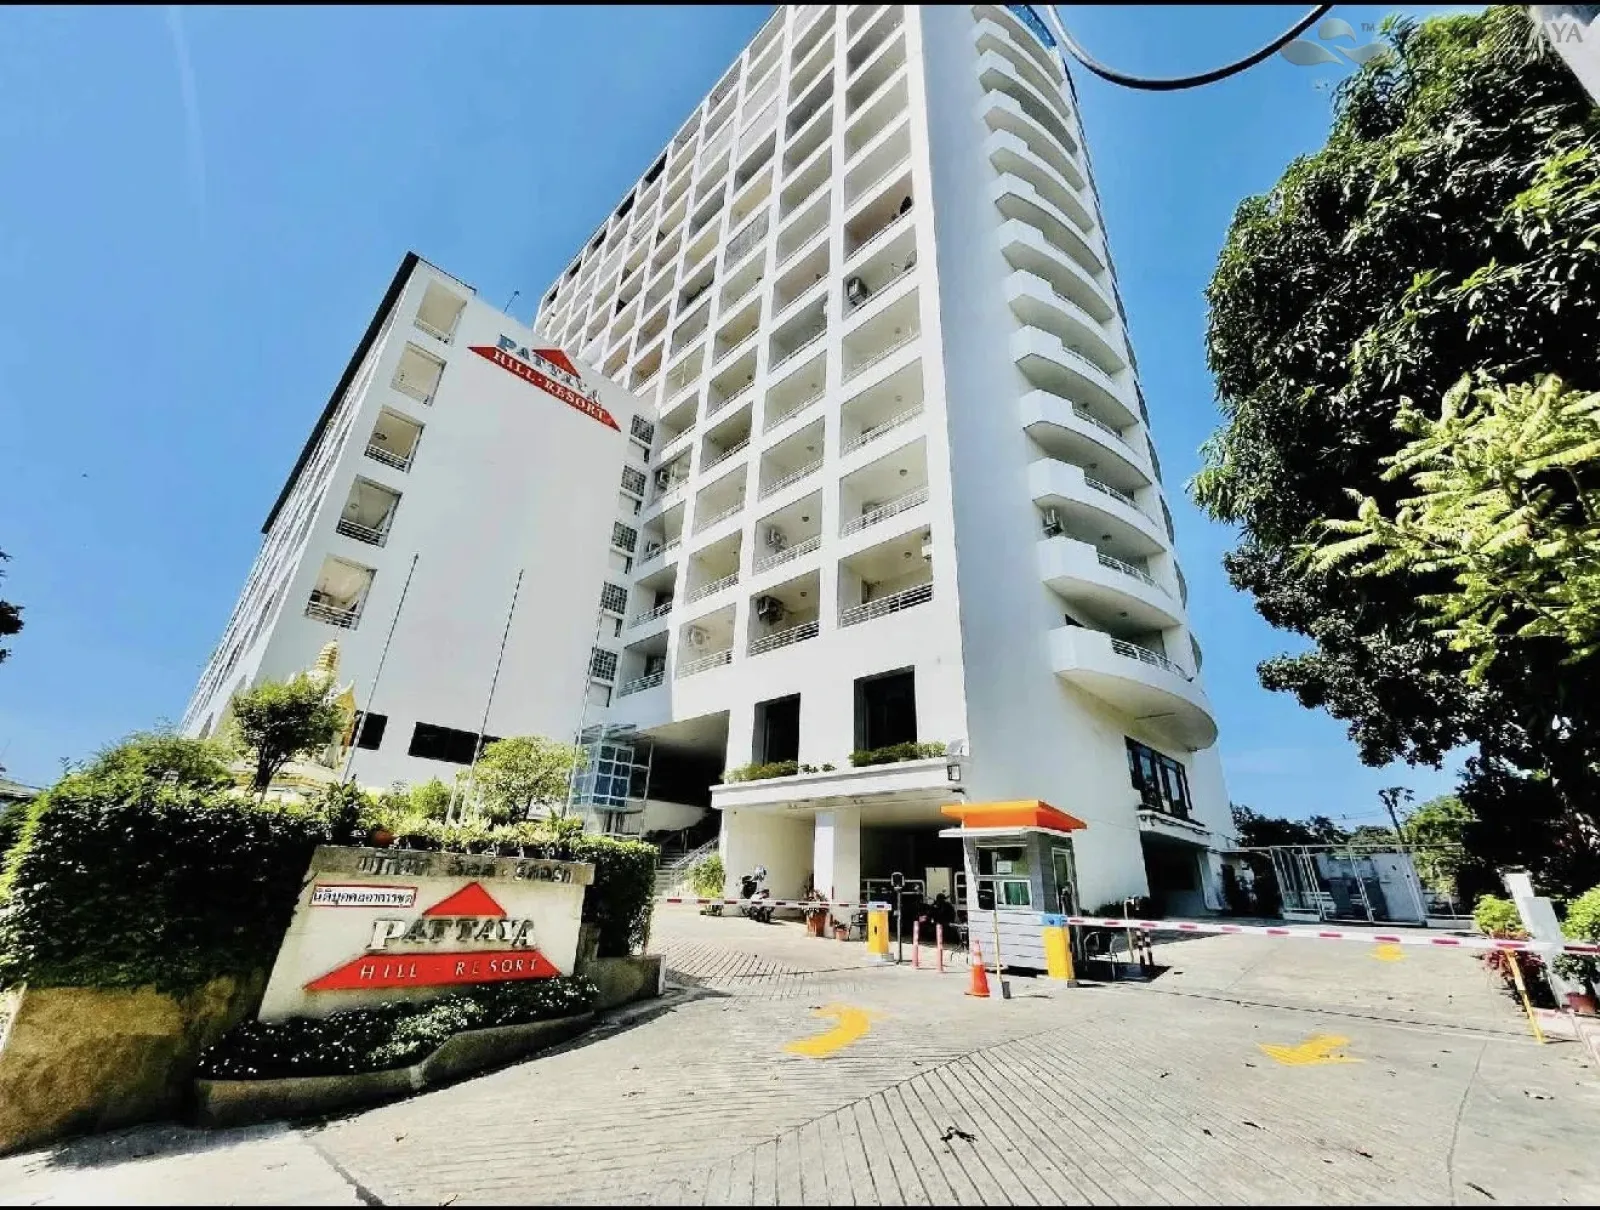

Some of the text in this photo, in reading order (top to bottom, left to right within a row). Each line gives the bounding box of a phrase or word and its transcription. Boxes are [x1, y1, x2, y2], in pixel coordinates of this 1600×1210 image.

[493, 350, 605, 419] HILL RESORT
[366, 919, 537, 950] PATTAYA
[359, 959, 538, 980] HILL RESORT
